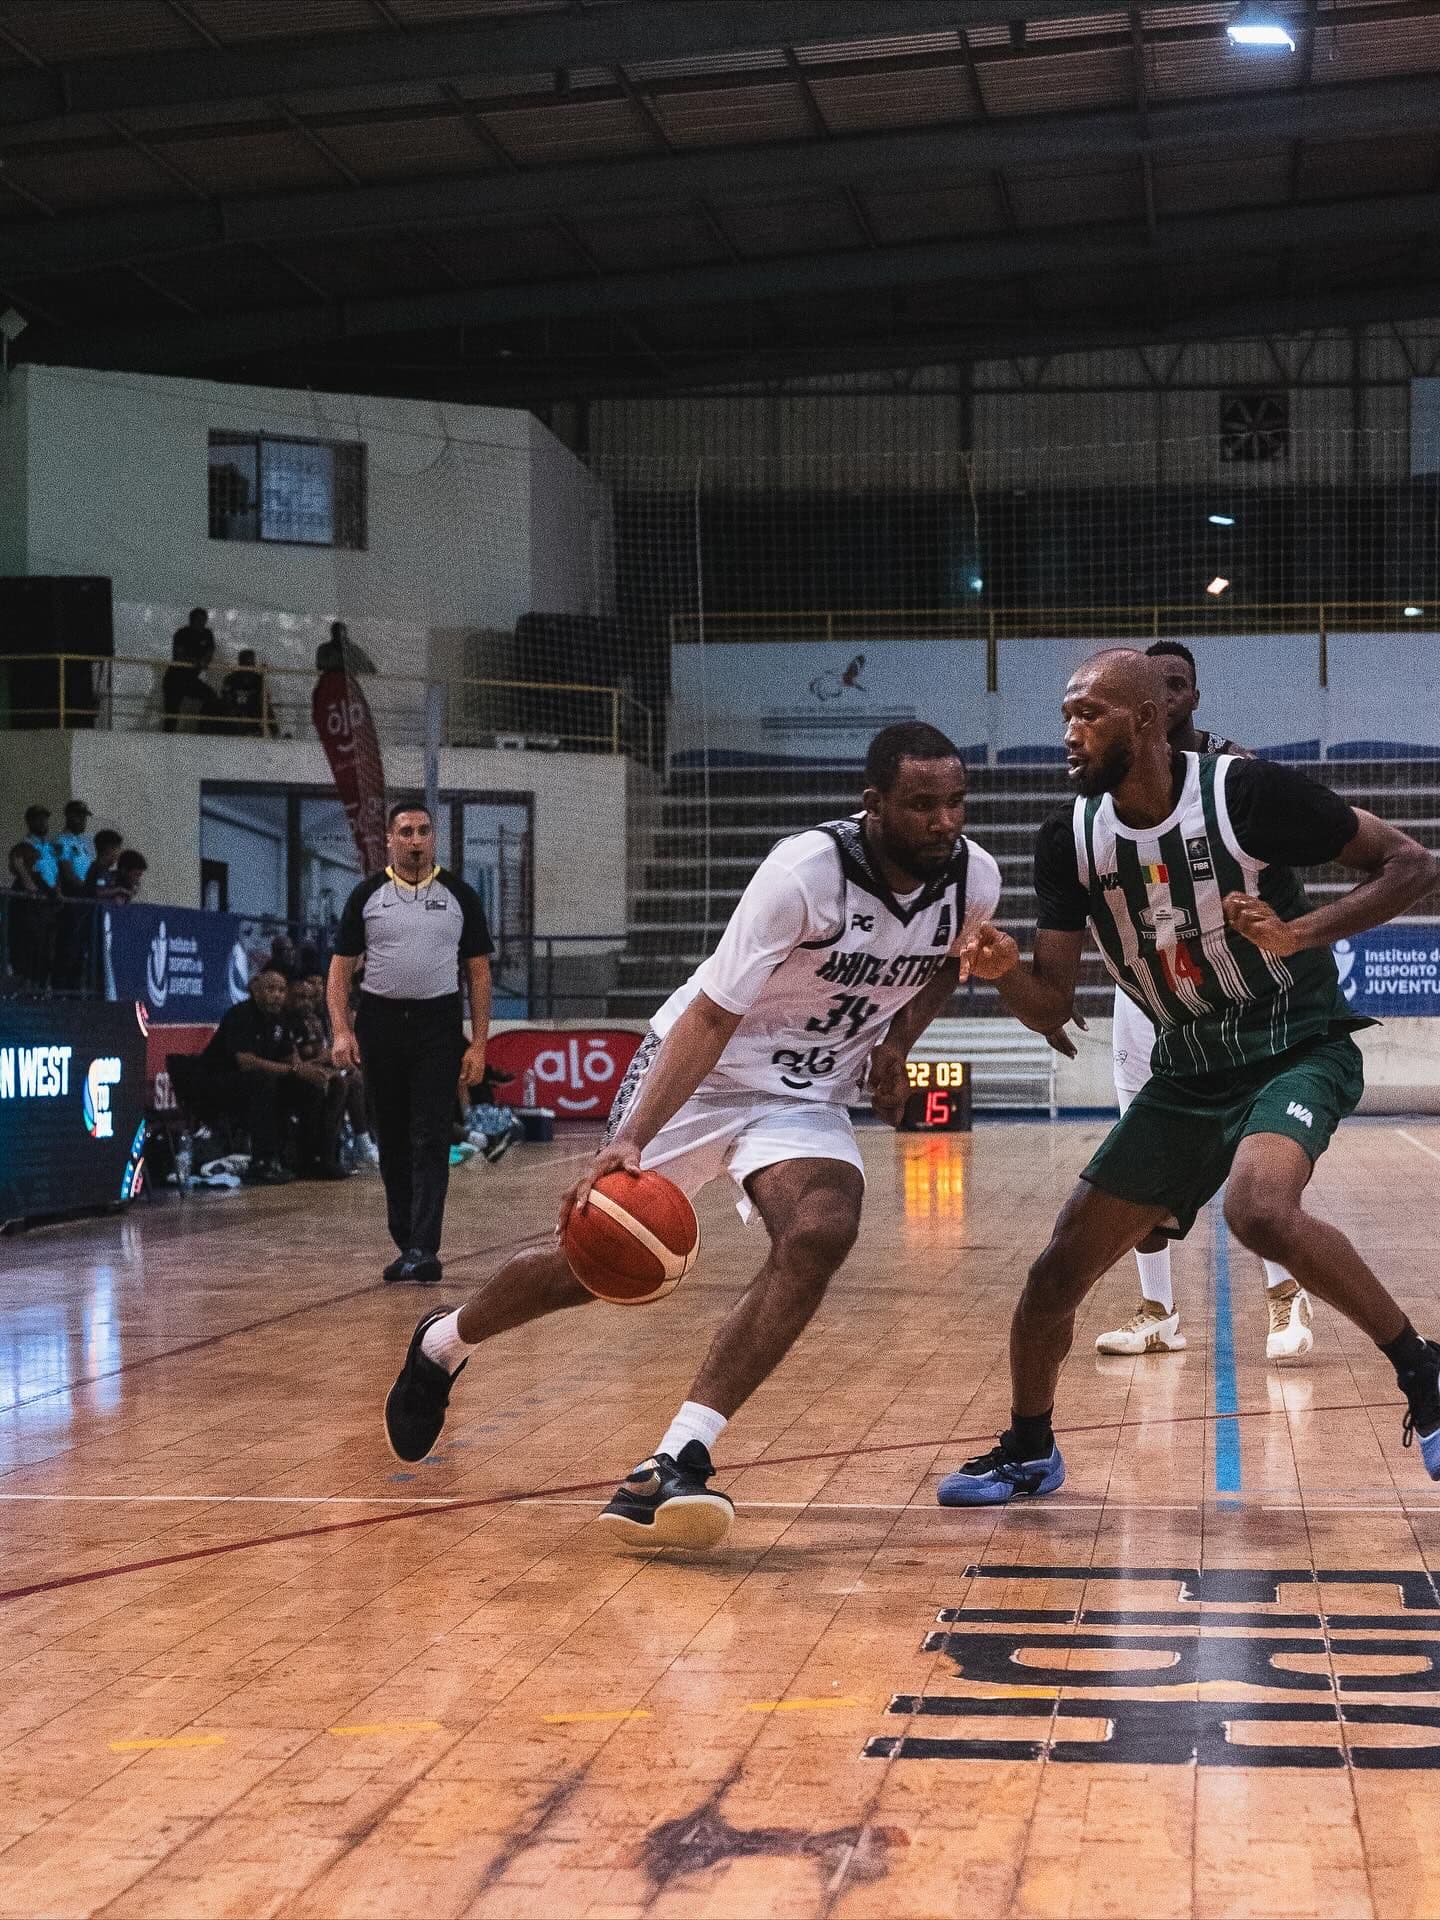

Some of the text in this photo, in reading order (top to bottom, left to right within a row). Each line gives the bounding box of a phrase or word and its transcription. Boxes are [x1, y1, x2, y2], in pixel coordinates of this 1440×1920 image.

[1158, 943, 1202, 992] 14
[1365, 948, 1427, 963] Instituto
[1365, 964, 1437, 977] DESPORTO
[1365, 979, 1440, 995] JUVENTU
[805, 993, 880, 1039] 34
[18, 1045, 72, 1098] WEST
[936, 1062, 963, 1087] 03
[926, 1091, 950, 1124] 15
[1285, 1100, 1314, 1128] WA
